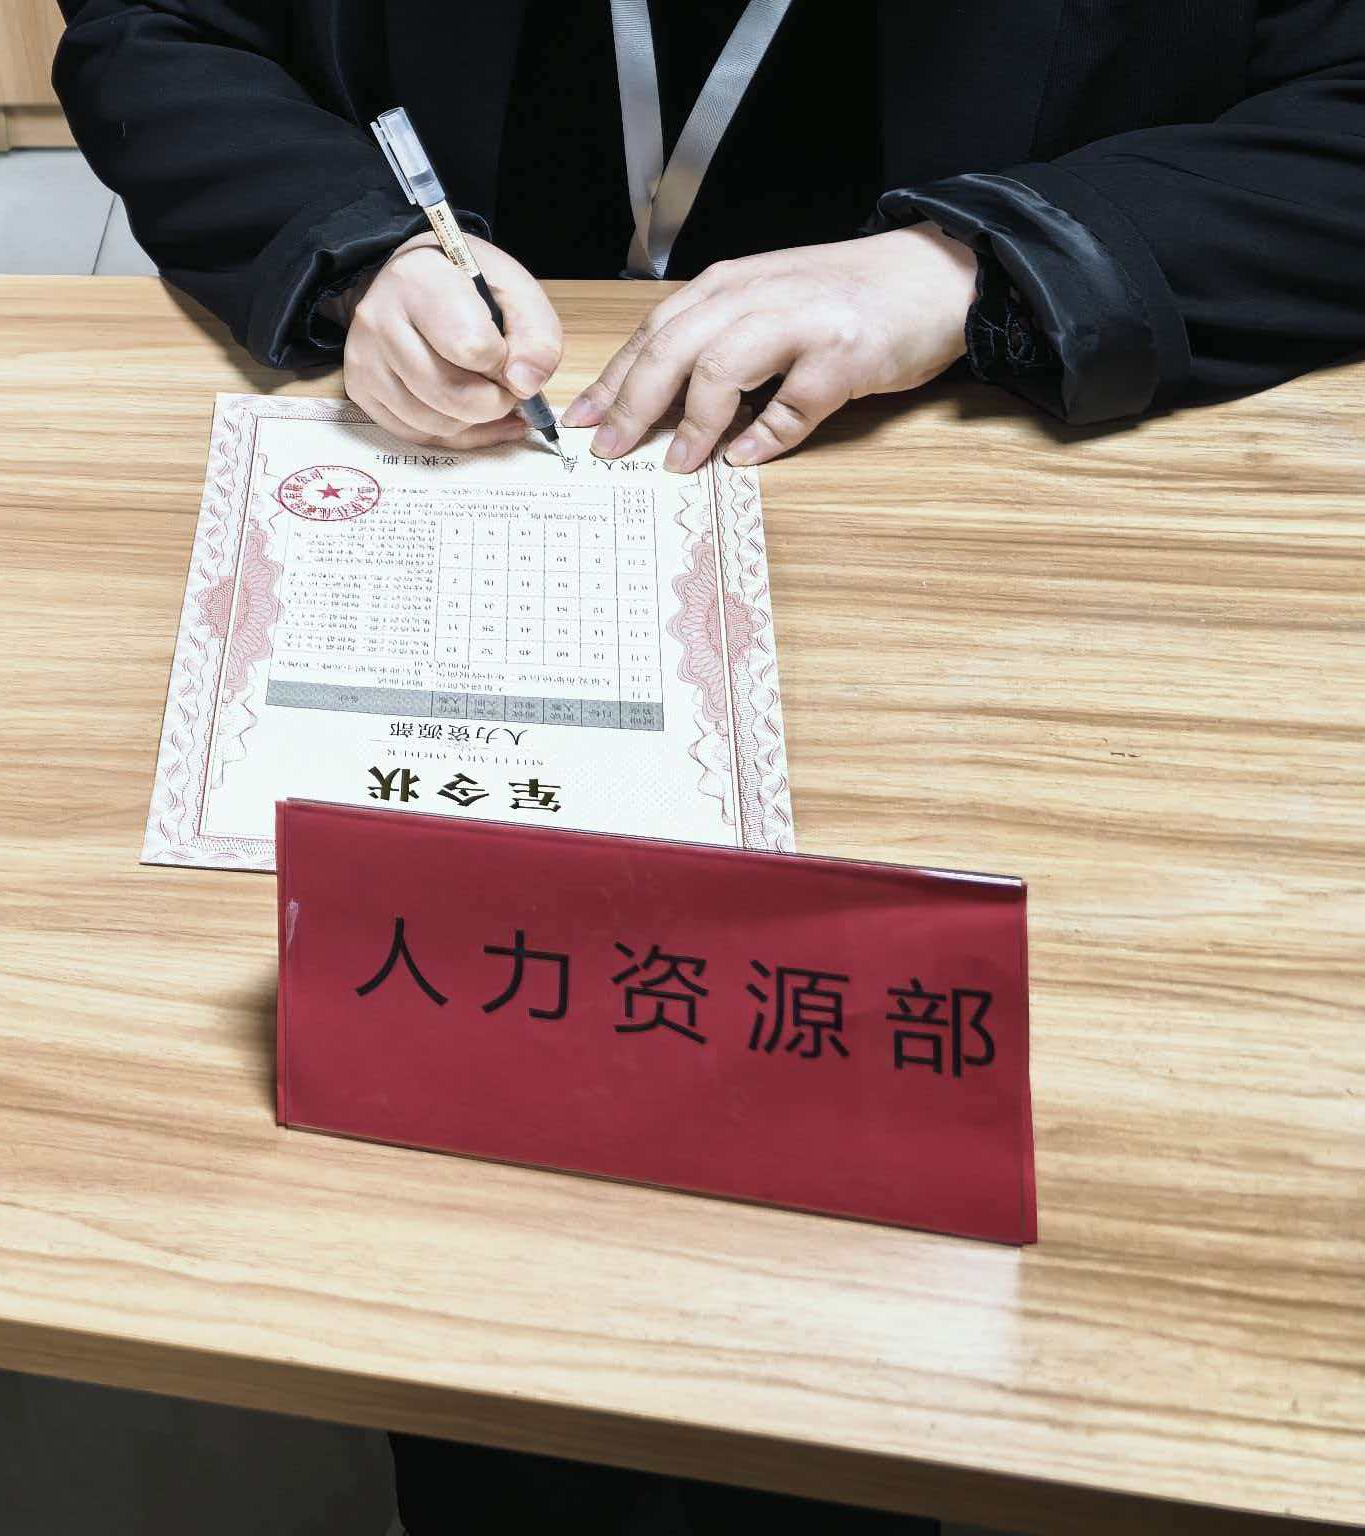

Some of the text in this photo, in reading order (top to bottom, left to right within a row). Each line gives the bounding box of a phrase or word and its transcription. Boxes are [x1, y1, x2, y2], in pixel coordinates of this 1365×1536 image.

[388, 721, 528, 746] 人力资源部
[366, 766, 562, 813] 军令状
[354, 916, 998, 1078] 人力资源部
